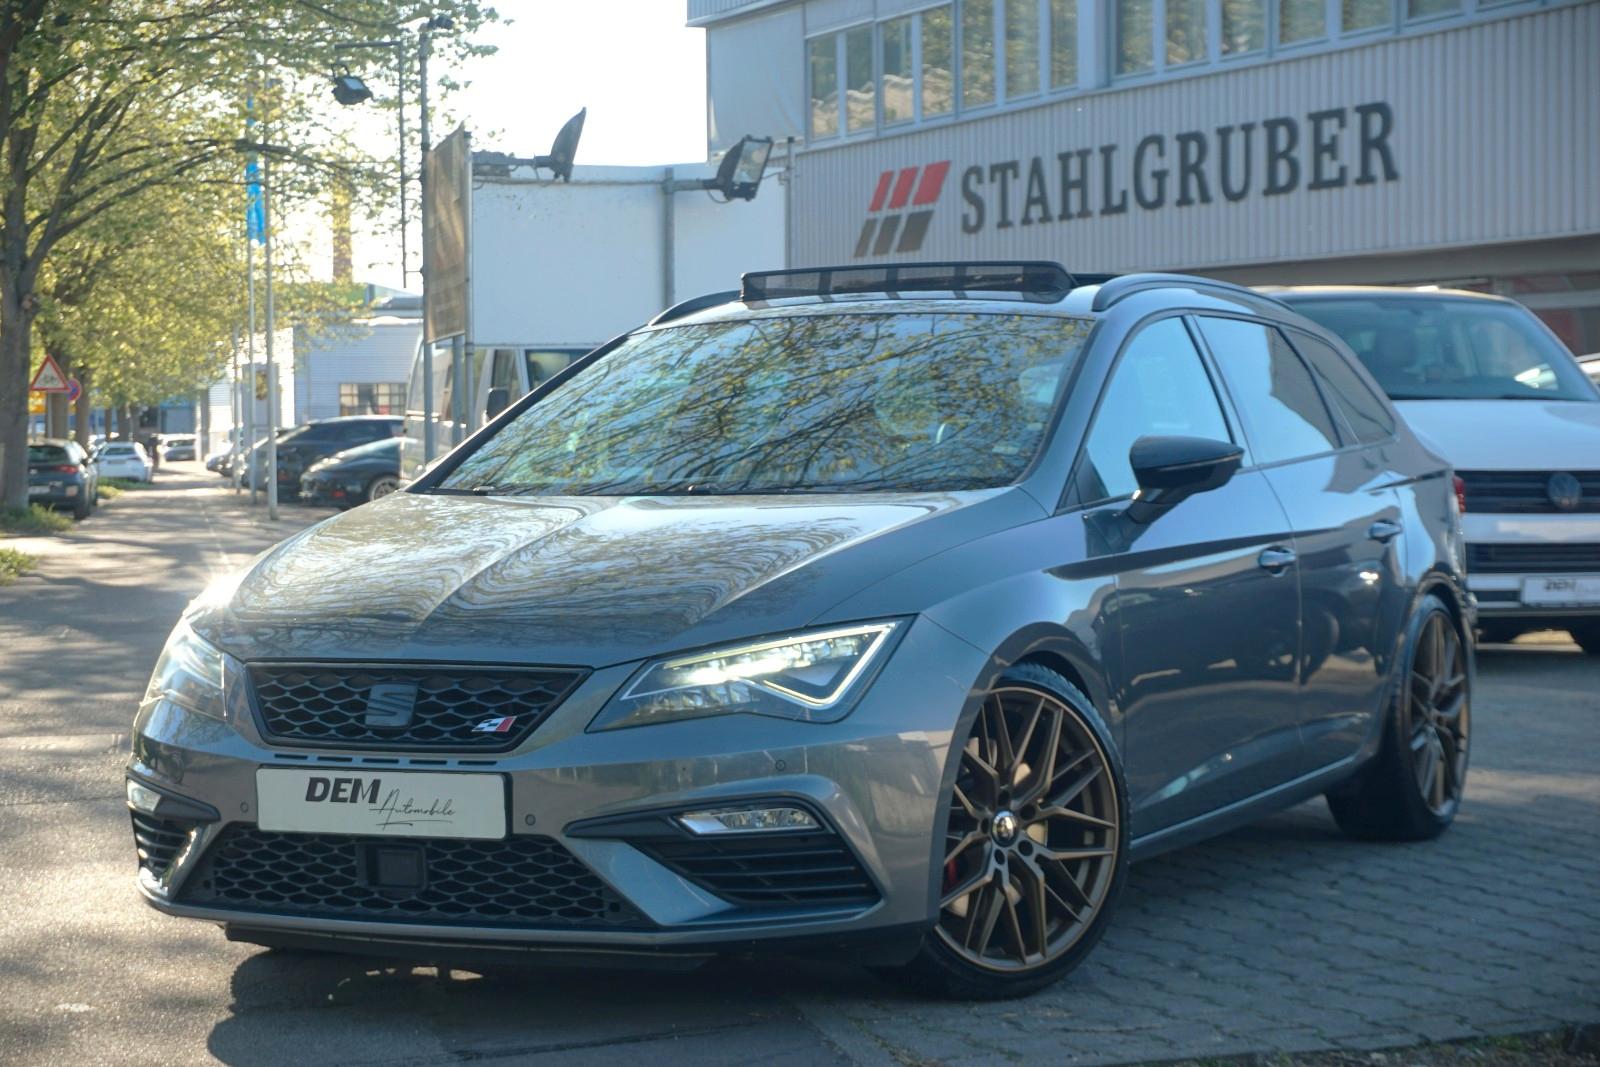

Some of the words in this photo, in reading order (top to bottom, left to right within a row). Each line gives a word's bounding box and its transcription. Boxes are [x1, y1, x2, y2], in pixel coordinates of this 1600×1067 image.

[961, 101, 1399, 234] STAHLGRUBER
[305, 776, 382, 804] DEM
[368, 788, 456, 831] Automobile
